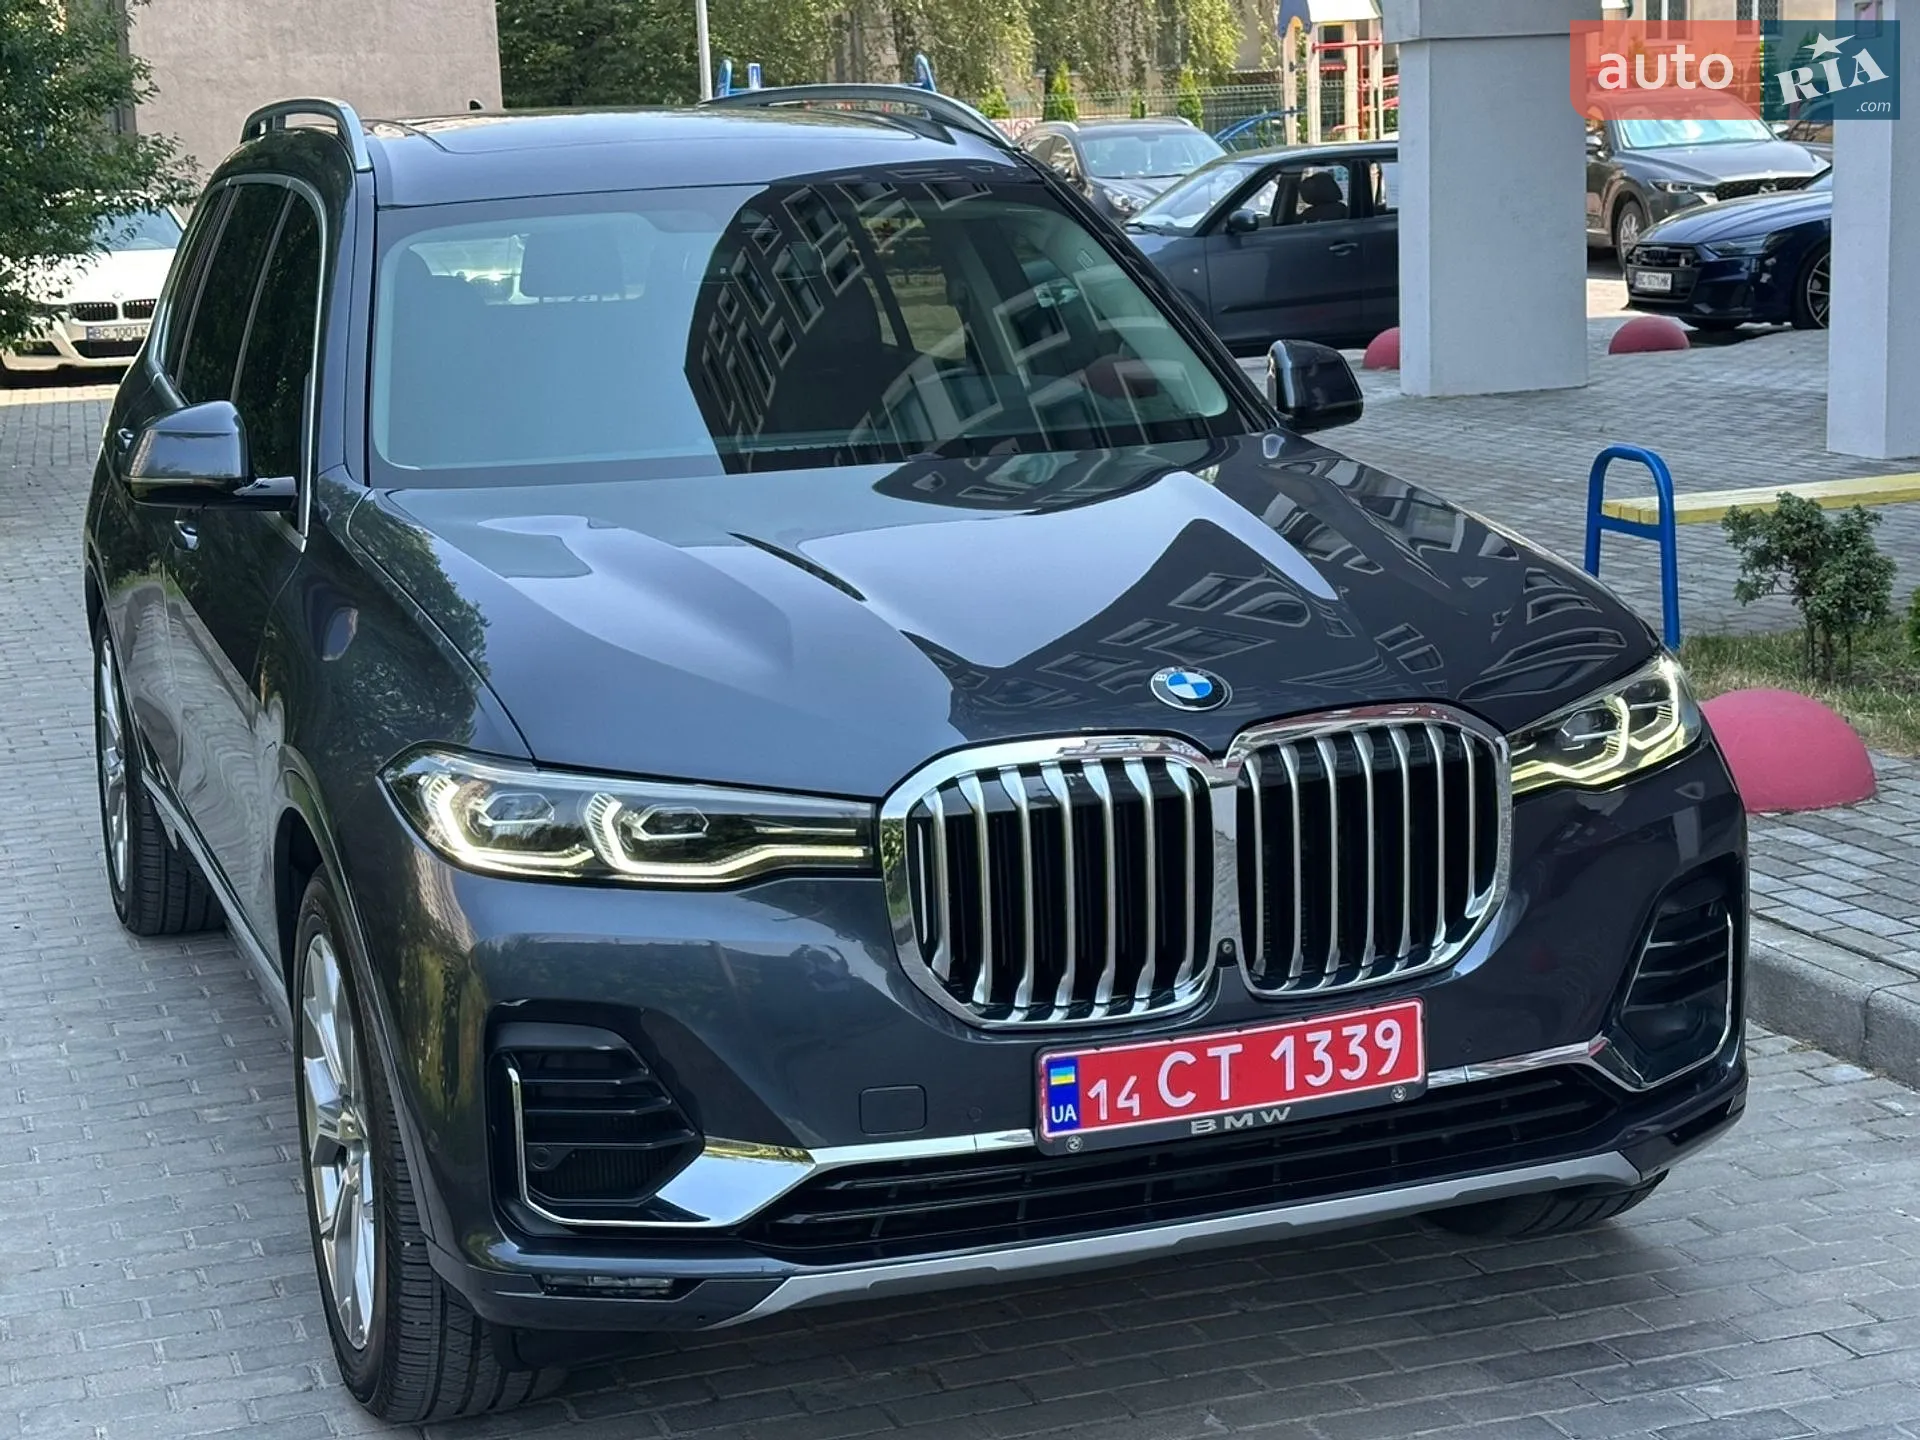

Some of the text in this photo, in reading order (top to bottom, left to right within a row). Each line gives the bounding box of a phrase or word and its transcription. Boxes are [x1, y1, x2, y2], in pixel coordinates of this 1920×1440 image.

[1087, 1018, 1403, 1121] 14 CT 1339
[1051, 1104, 1078, 1124] UA
[1190, 1106, 1291, 1135] BMW
